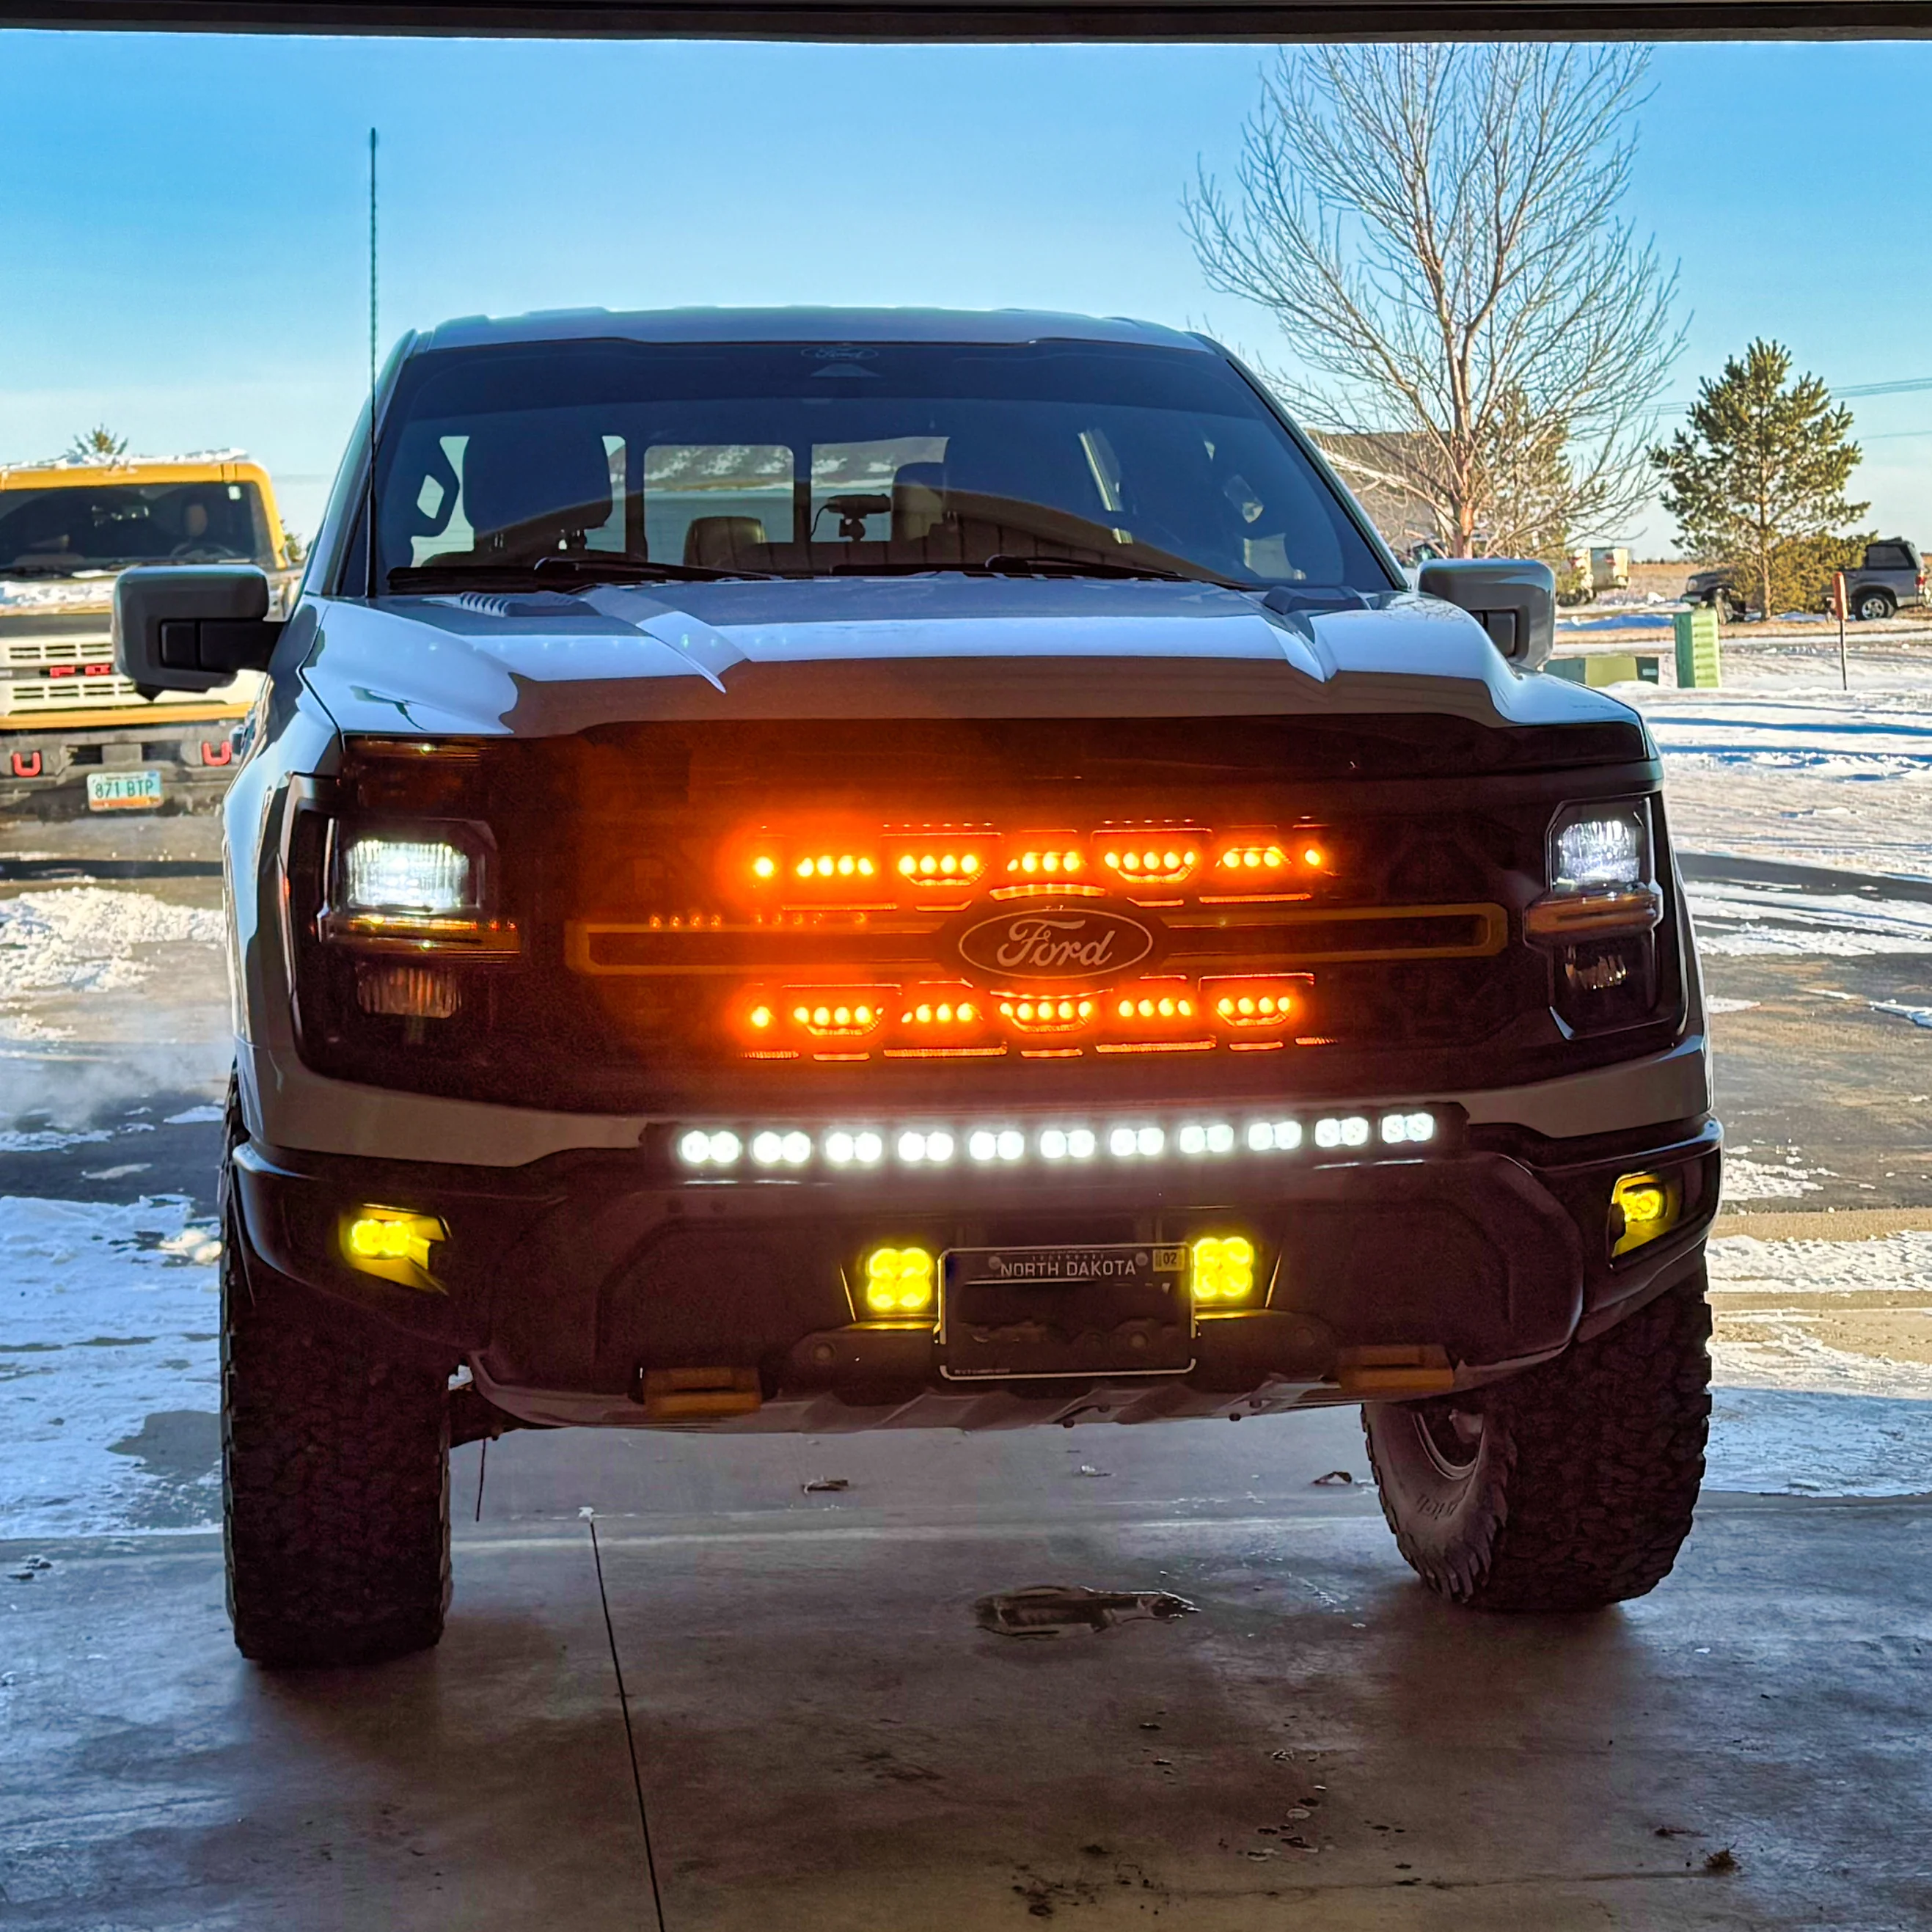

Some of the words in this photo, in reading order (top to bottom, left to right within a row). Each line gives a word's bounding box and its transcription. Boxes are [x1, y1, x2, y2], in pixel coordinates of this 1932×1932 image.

[95, 781, 120, 799] 871
[126, 779, 153, 797] BTP
[996, 918, 1116, 967] Ford
[1163, 1251, 1177, 1265] 02
[1000, 1261, 1059, 1278] NORTH
[1066, 1259, 1137, 1277] DAKOTA
